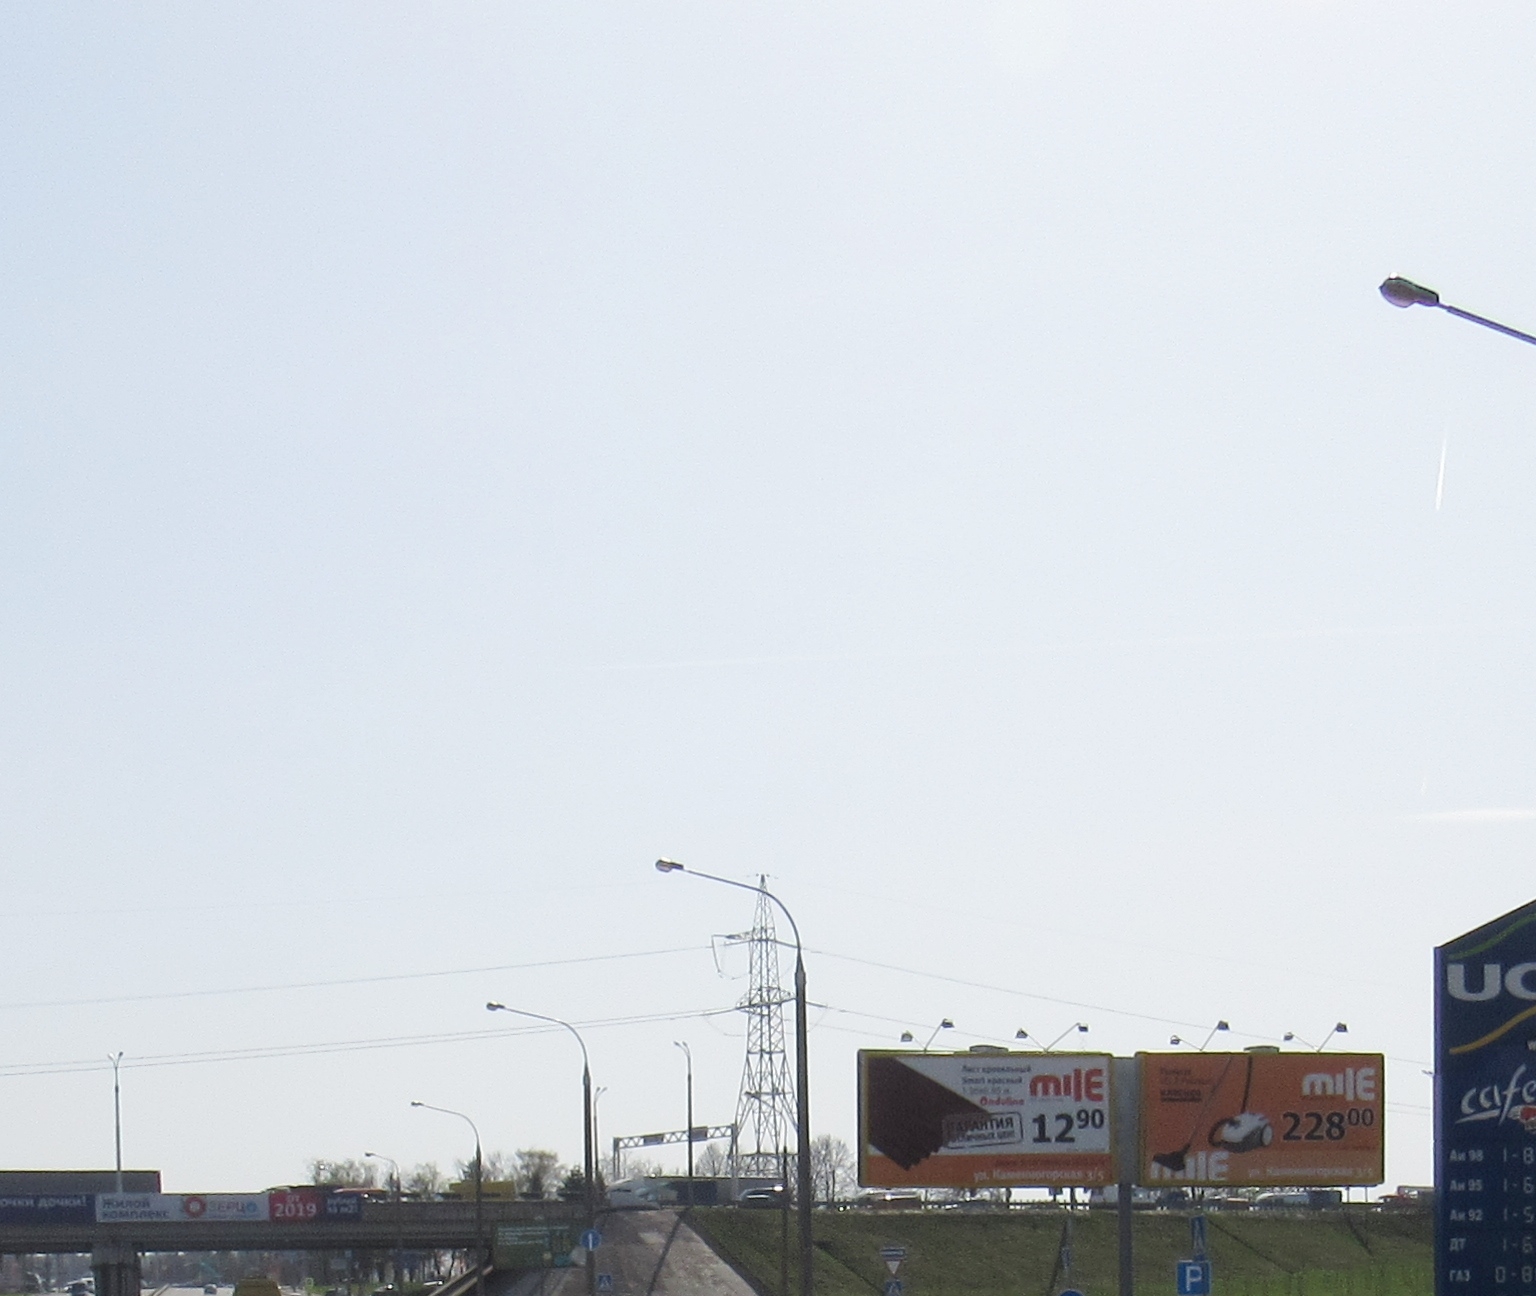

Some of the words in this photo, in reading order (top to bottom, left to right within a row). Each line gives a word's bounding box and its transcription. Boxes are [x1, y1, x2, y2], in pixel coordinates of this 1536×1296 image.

[1468, 1149, 1483, 1162] 98
[1468, 1179, 1483, 1191] 95
[274, 1202, 317, 1218] 2019
[1468, 1209, 1483, 1221] 92
[1185, 1265, 1202, 1292] P
[1449, 1269, 1471, 1282] ГАЗ
